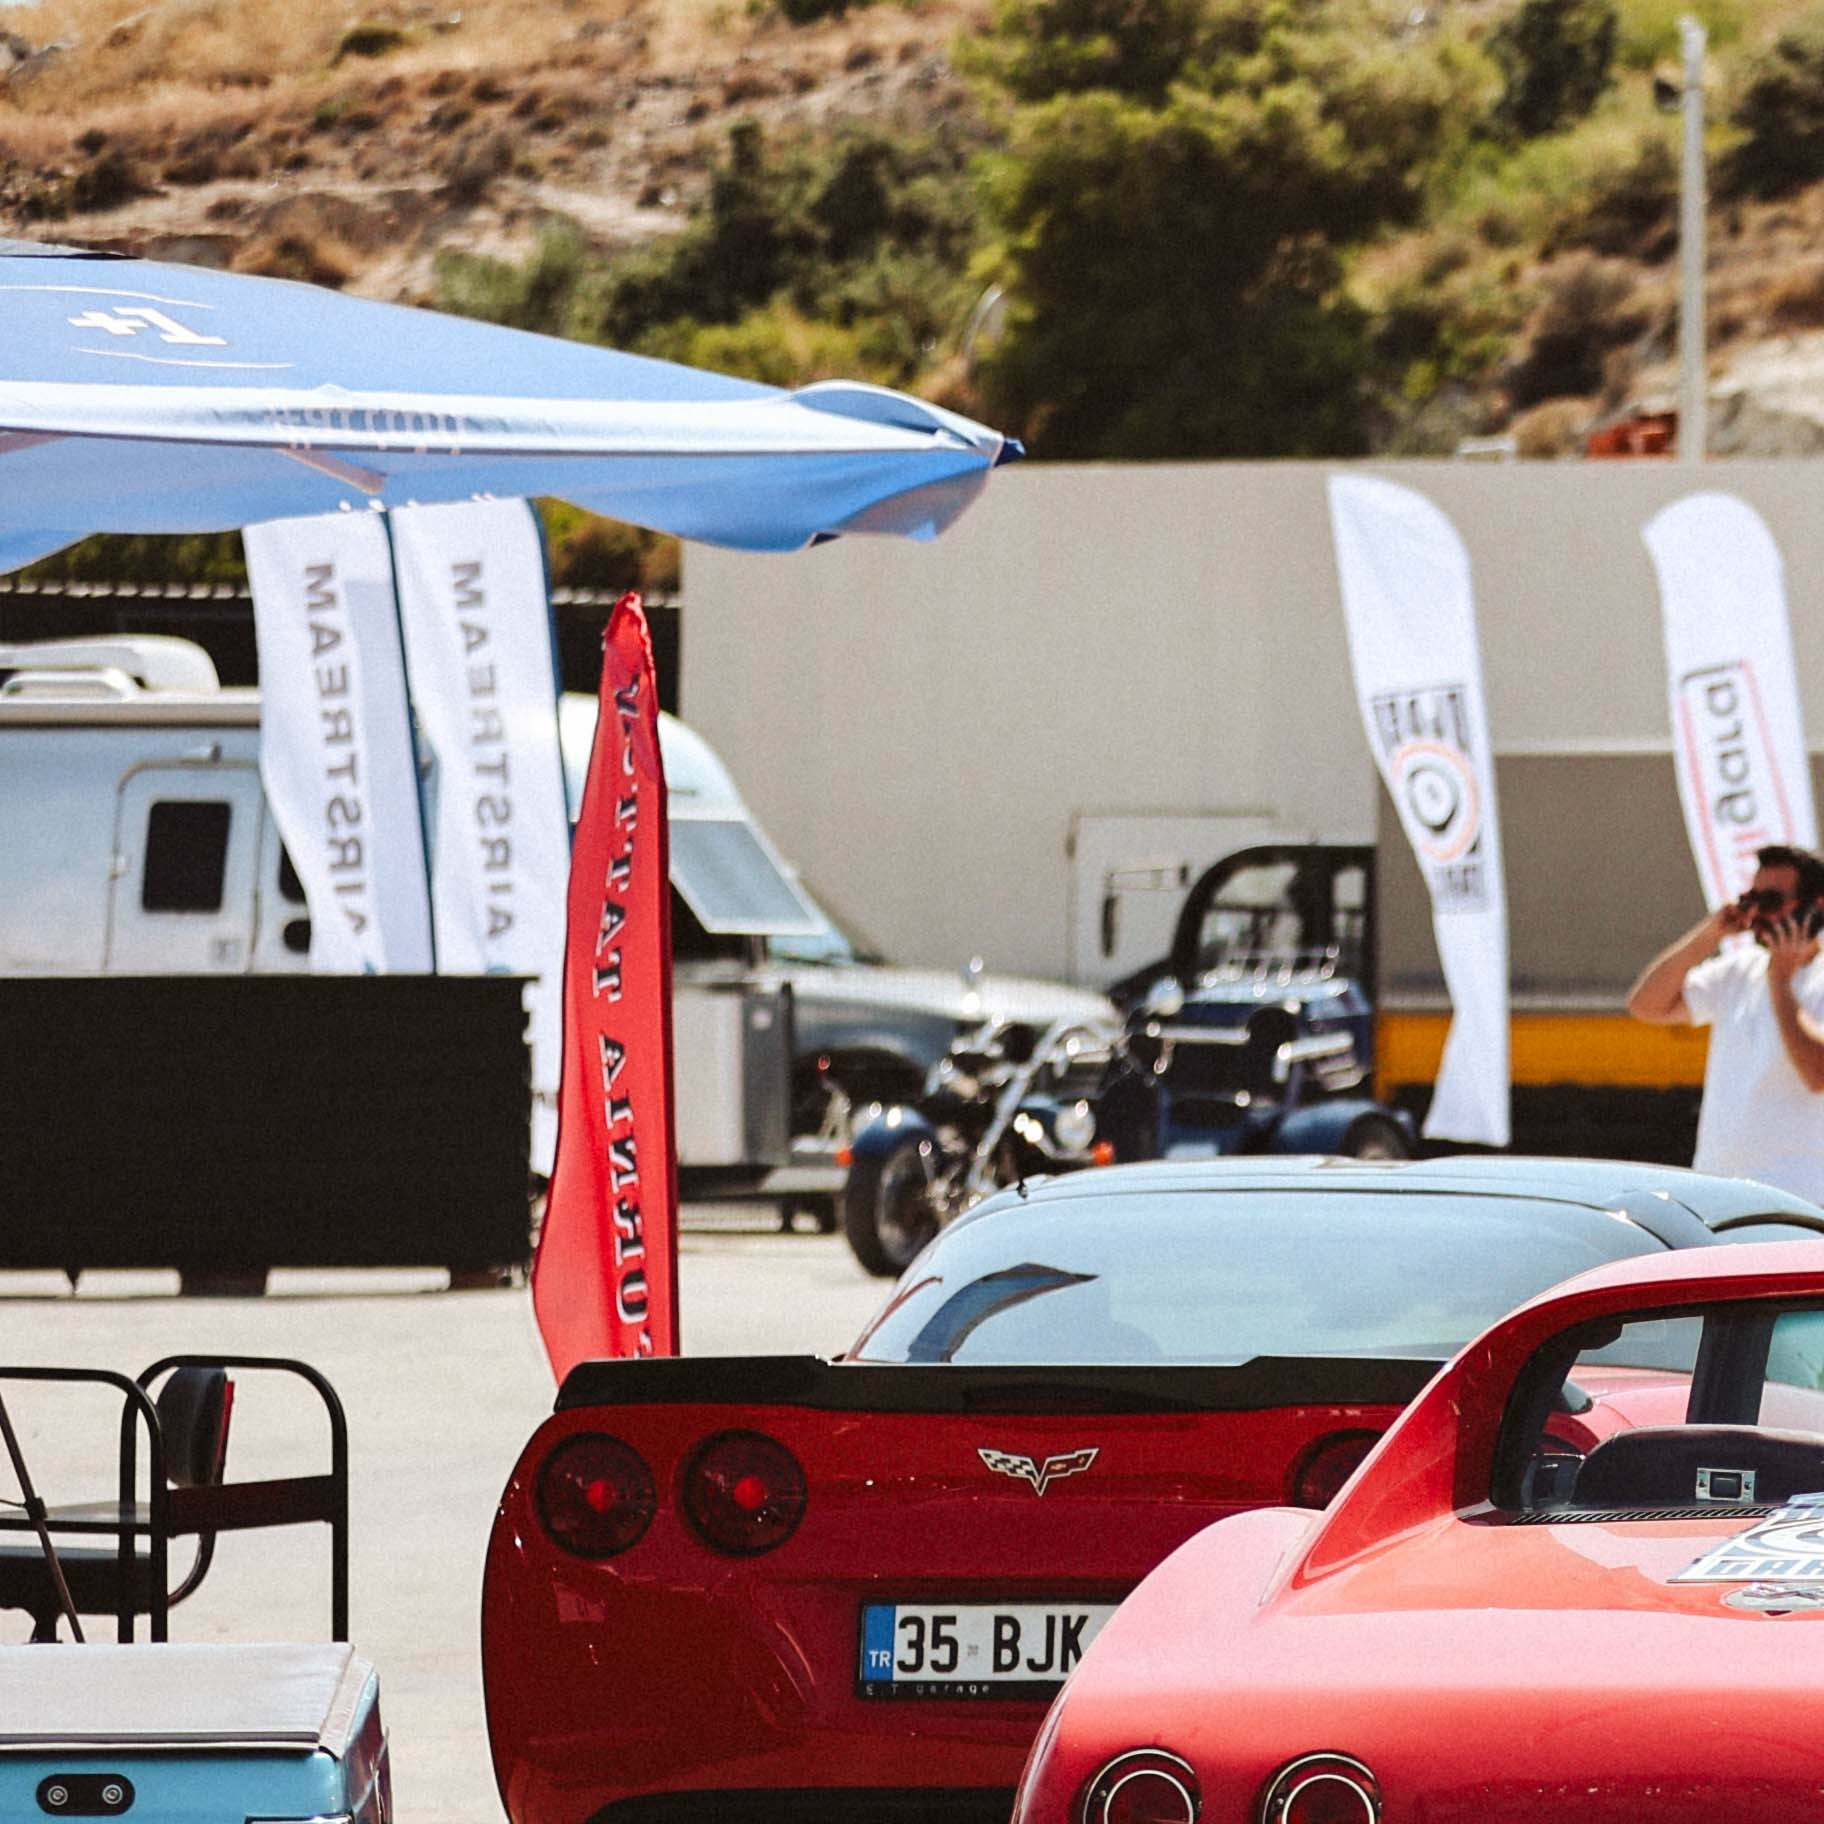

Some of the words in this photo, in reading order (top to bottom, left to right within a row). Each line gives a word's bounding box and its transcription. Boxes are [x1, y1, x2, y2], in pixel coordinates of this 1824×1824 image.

[868, 1650, 892, 1669] TR
[896, 1615, 959, 1673] 35
[992, 1614, 1089, 1673] BJK
